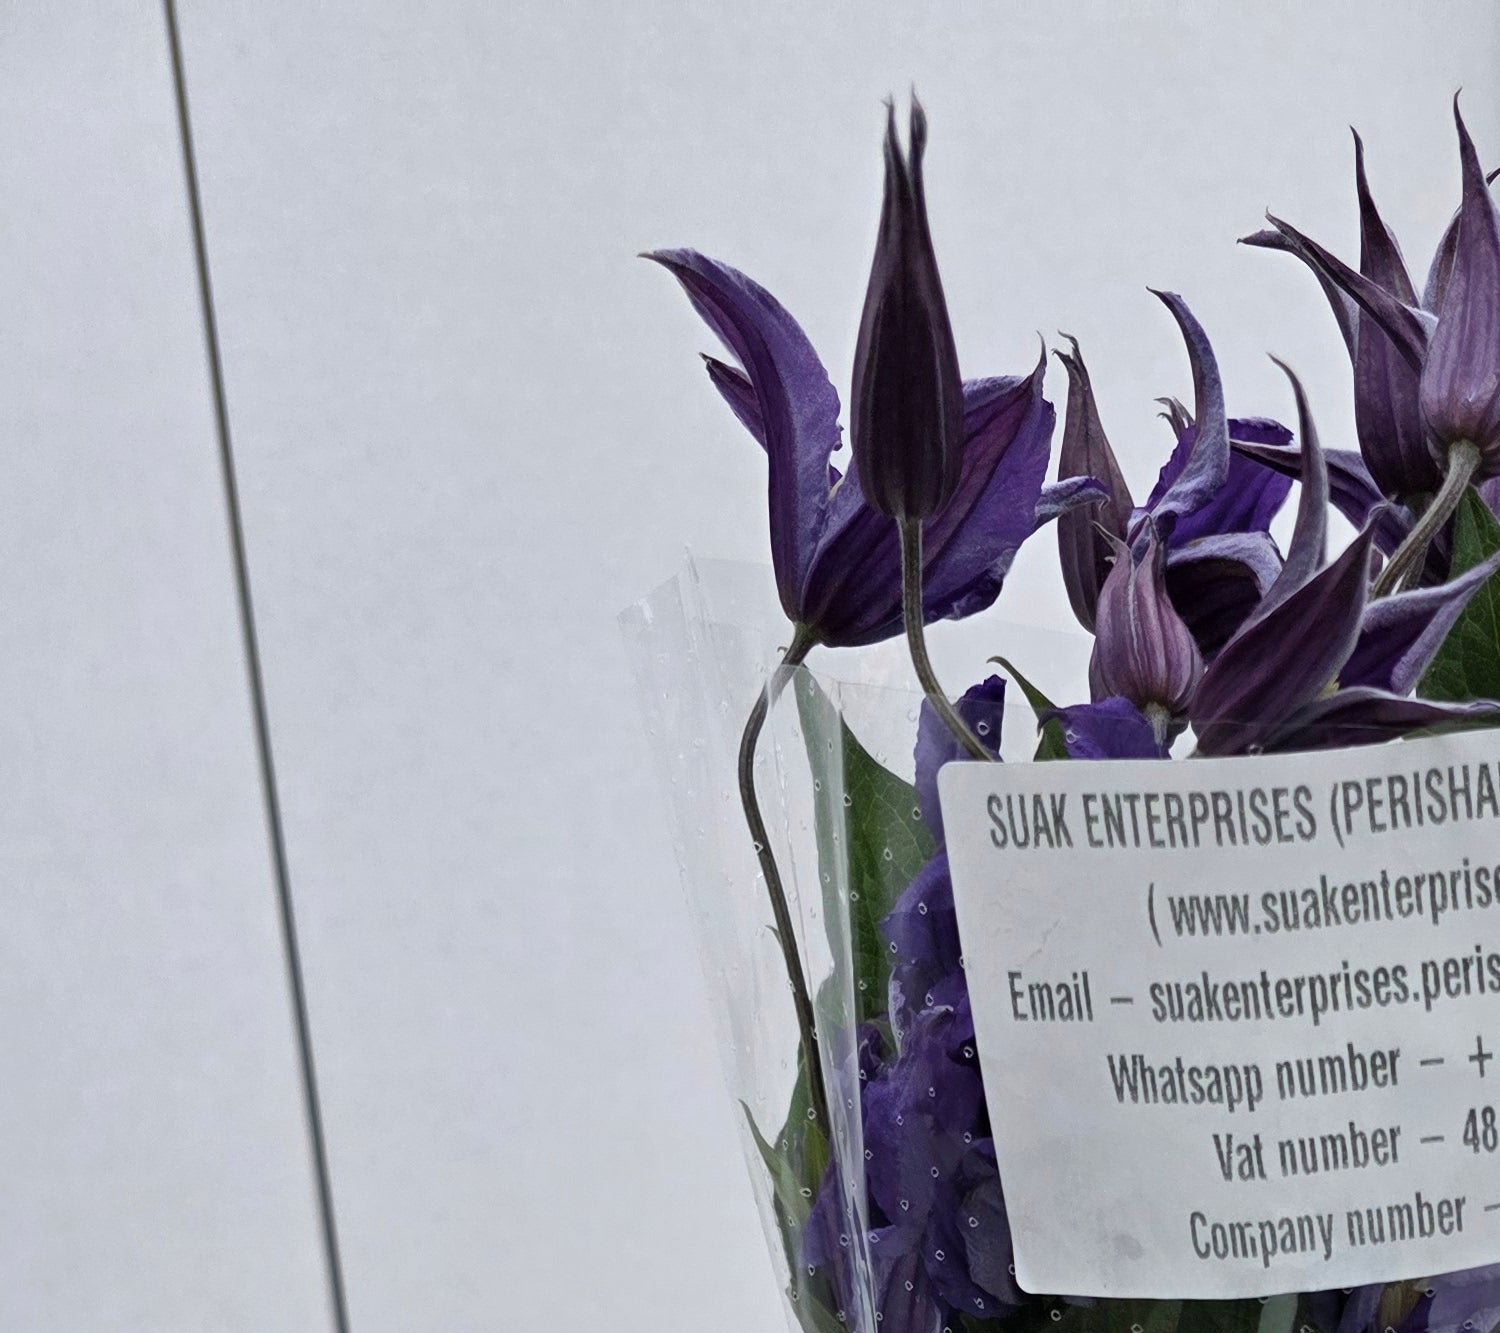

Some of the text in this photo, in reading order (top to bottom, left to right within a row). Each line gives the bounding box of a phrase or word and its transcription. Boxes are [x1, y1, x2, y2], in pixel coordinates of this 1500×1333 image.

[986, 792, 1073, 850] SUAK
[1082, 784, 1318, 849] ENTERPRISES
[1007, 971, 1094, 1023] Email
[1107, 1053, 1264, 1114] Whatsapp
[1275, 1041, 1401, 1101] number
[1212, 1132, 1268, 1183] Vat
[1278, 1120, 1402, 1178] number
[1189, 1210, 1335, 1270] Company
[1346, 1190, 1467, 1248] number
